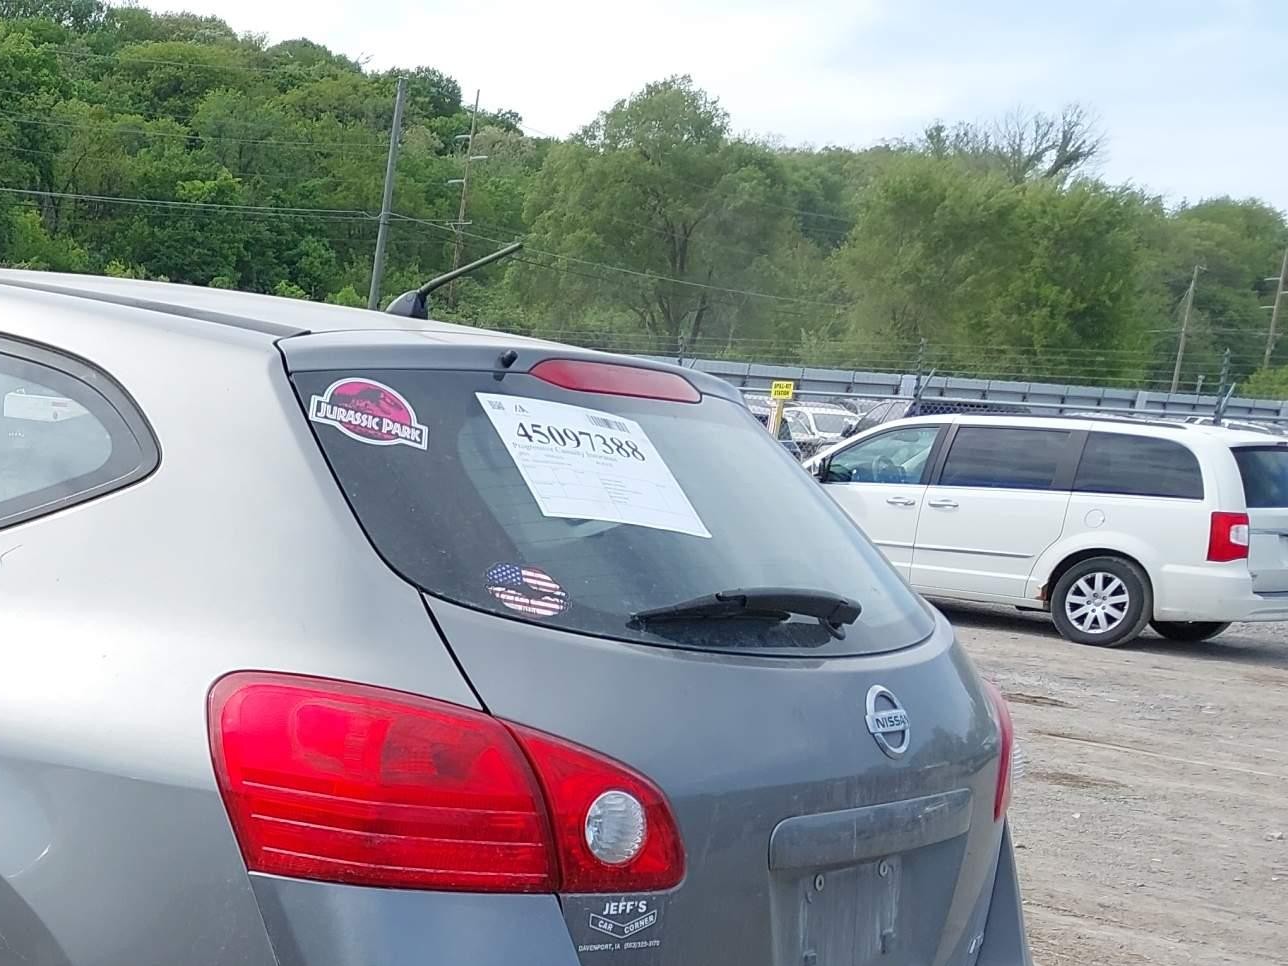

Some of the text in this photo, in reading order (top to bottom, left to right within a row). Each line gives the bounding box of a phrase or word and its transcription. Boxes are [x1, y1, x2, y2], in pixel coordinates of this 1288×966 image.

[317, 401, 421, 442] JURASSIC PARK
[516, 421, 646, 462] 45097388
[602, 900, 648, 915] JEFF'S
[598, 914, 654, 934] CAR CORNER
